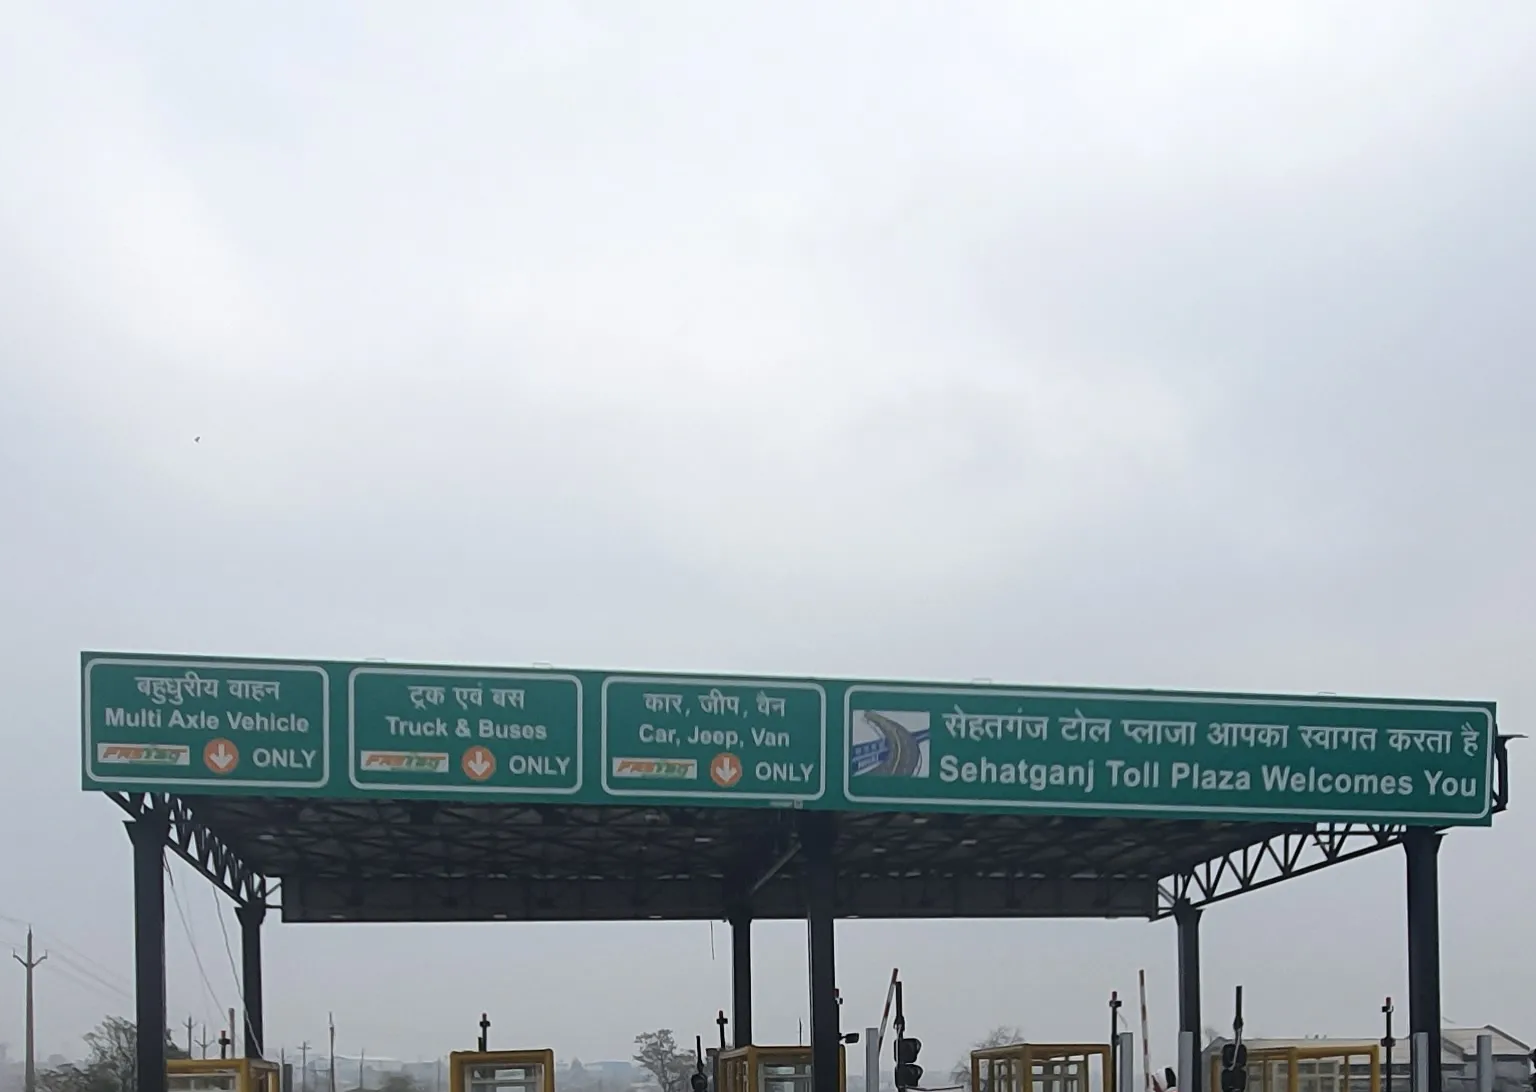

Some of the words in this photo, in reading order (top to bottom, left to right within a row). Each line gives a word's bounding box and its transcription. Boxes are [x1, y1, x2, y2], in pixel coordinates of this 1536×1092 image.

[133, 670, 220, 706] बहुधुरीय
[226, 679, 281, 702] वाहन
[451, 682, 484, 710] एवं
[490, 688, 525, 710] बस
[104, 707, 162, 728] Multi
[167, 709, 220, 730] Axle
[226, 711, 310, 733] Vehicle
[385, 715, 449, 737] Truck
[454, 718, 472, 738] &
[478, 718, 548, 740] Buses
[941, 703, 1050, 741] सेहतगंज
[1058, 708, 1112, 743] टोल
[1119, 719, 1198, 746] प्लाजा
[1206, 722, 1290, 749] आपका
[1297, 725, 1378, 752] स्वागत
[1386, 728, 1453, 754] करता
[1460, 721, 1480, 757] है
[638, 723, 681, 747] Car,
[687, 725, 744, 750] Jeep,
[750, 727, 790, 747] Van
[252, 747, 317, 769] ONLY
[508, 754, 571, 776] ONLY
[755, 761, 814, 782] ONLY
[939, 754, 1094, 793] Sehatganj
[1105, 759, 1160, 788] Toll
[1171, 761, 1251, 791] Plaza
[1261, 764, 1414, 796] Welcomes
[1423, 769, 1477, 797] You
